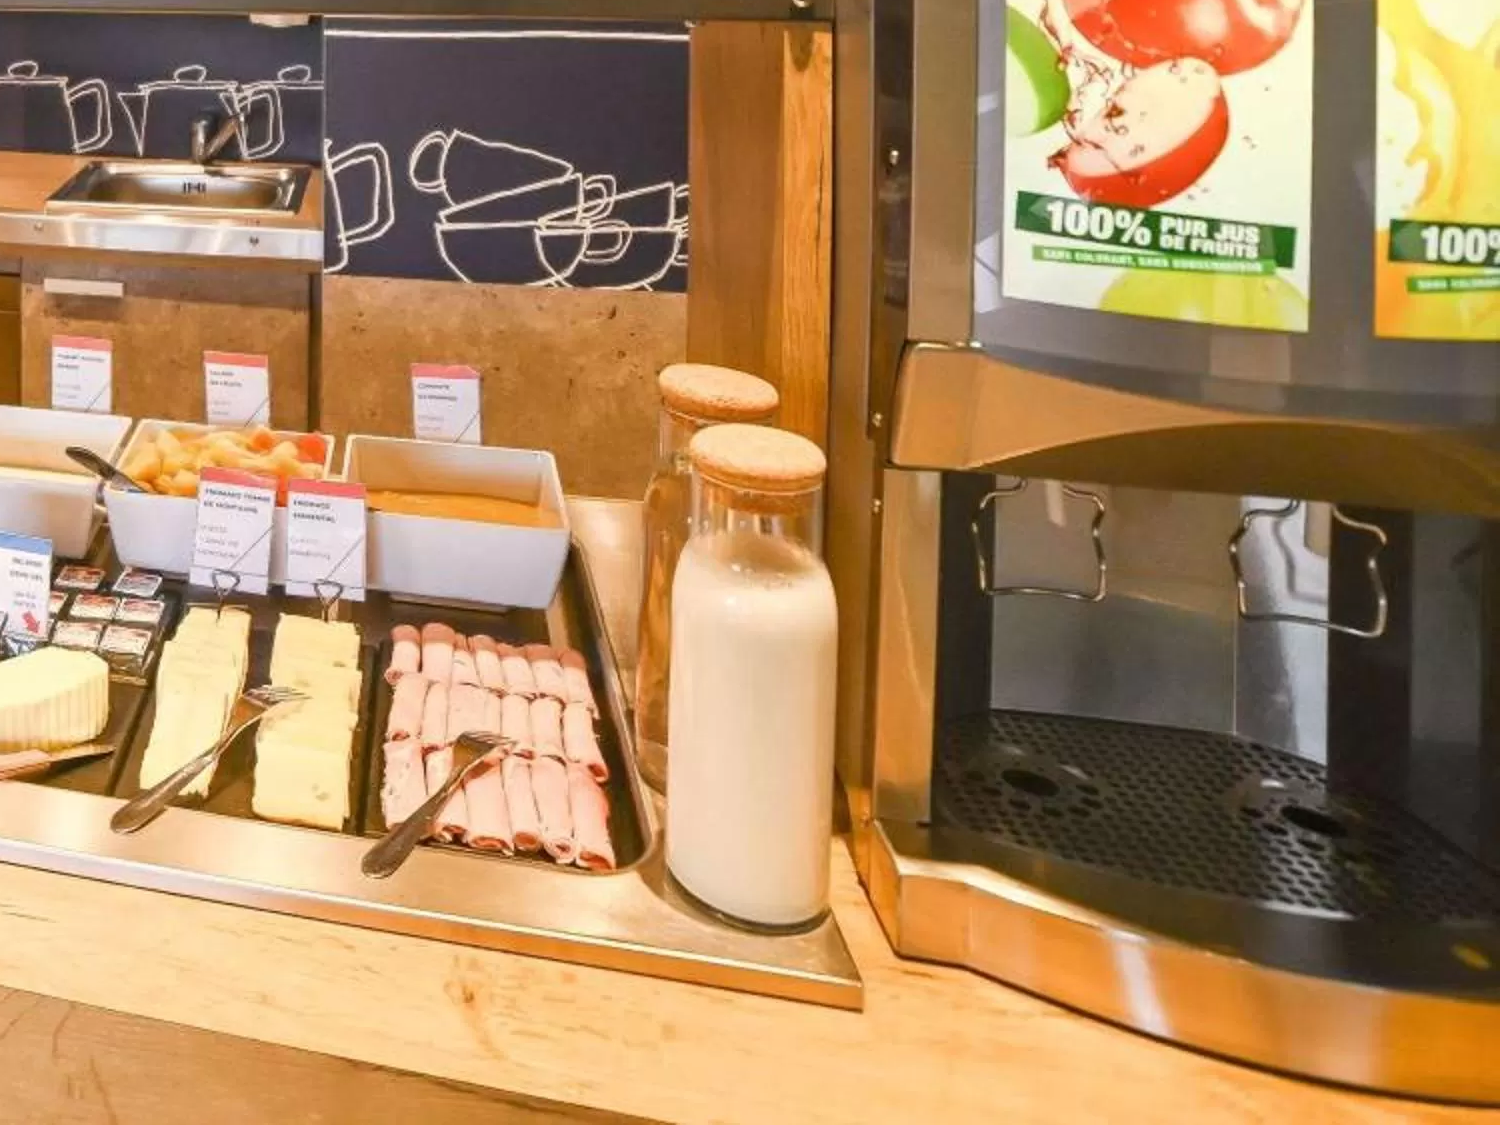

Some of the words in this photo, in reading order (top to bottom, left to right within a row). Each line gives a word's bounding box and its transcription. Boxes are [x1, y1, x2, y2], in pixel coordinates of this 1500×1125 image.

[1047, 200, 1152, 246] 100%
[1159, 215, 1207, 238] PUR
[1214, 223, 1260, 244] JUS
[1159, 234, 1183, 251] DE
[1189, 237, 1259, 259] FRUITS
